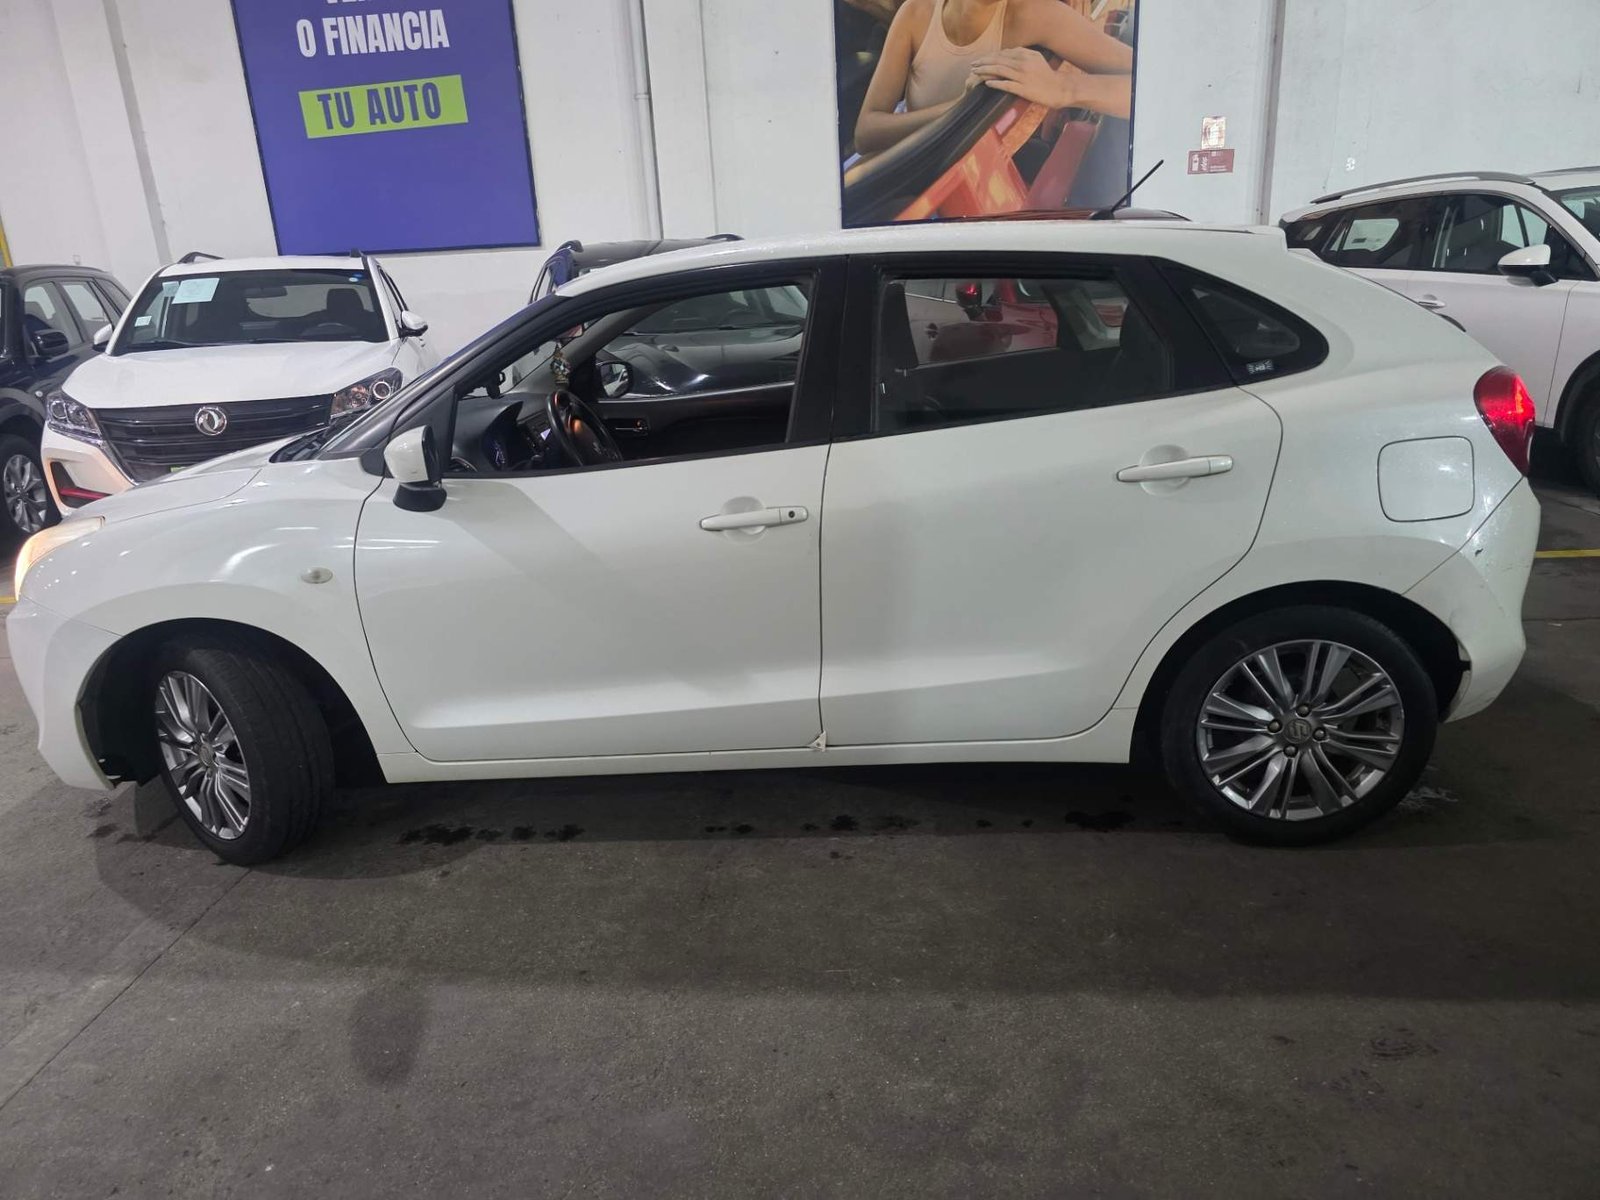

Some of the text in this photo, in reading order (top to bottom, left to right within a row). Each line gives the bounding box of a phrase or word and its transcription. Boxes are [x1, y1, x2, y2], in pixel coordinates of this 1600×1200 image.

[296, 9, 450, 58] O FINANCIA
[317, 82, 442, 130] TU AUTO
